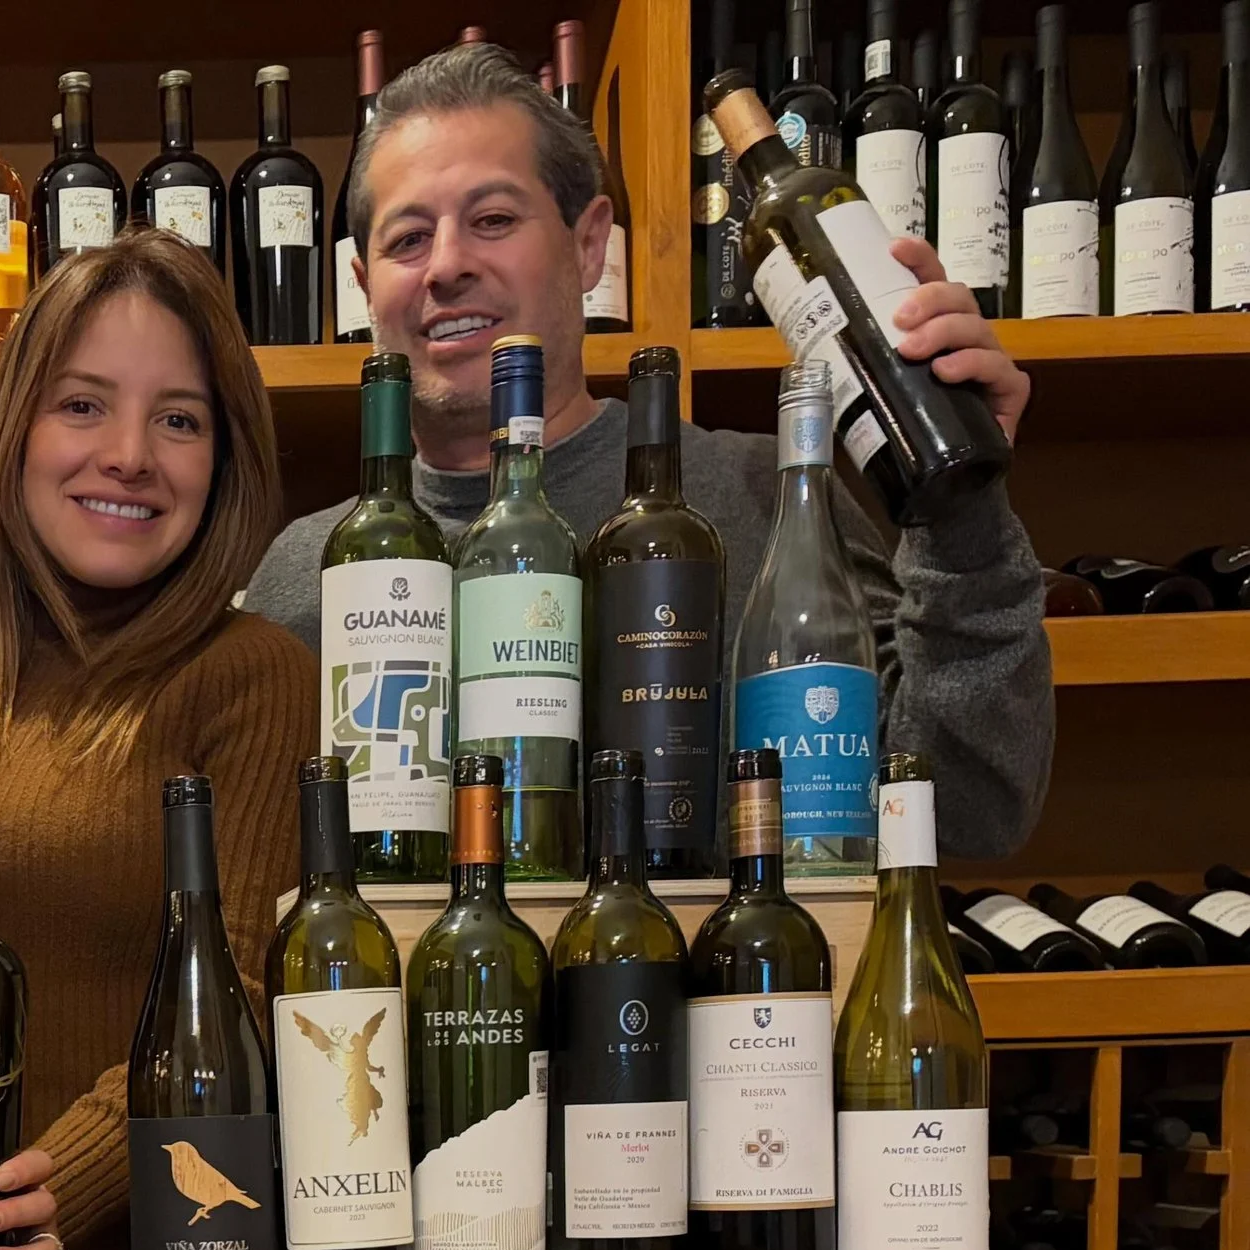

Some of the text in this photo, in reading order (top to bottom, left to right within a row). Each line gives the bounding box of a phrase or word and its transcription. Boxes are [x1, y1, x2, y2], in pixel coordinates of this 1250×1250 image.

[799, 134, 811, 165] édito
[343, 607, 447, 631] GUANAMÉ
[348, 632, 444, 647] SAUVIGNON BLANC
[617, 628, 708, 644] CAMINOCORAZÓN
[516, 697, 568, 709] RIESLING
[529, 709, 559, 718] CLASSIC
[762, 733, 870, 758] MATUA
[781, 783, 832, 793] AUVIGNON
[783, 810, 824, 819] OROUGH,
[423, 1008, 524, 1027] TERRAZAS
[427, 1028, 524, 1047] LOS ANDES
[729, 1036, 796, 1050] CECCHI
[608, 1043, 660, 1053] LEGAT
[706, 1060, 818, 1075] CHIANTI CLASSICO
[740, 1087, 787, 1098] RISERVA
[586, 1130, 676, 1139] VIÑA DE FRANNES
[912, 1121, 943, 1141] AG
[621, 1143, 650, 1153] Merlot
[923, 1145, 967, 1155] GOICHOT
[455, 1170, 503, 1179] RESERVA
[293, 1169, 407, 1199] ANXELIN
[456, 1179, 503, 1188] MALBEC
[715, 1187, 813, 1198] RISERVA DI FAMIGLIA
[889, 1182, 963, 1198] CHABLIS
[313, 1201, 396, 1214] CABERNET SAUVIGNON
[916, 1224, 939, 1232] 2022
